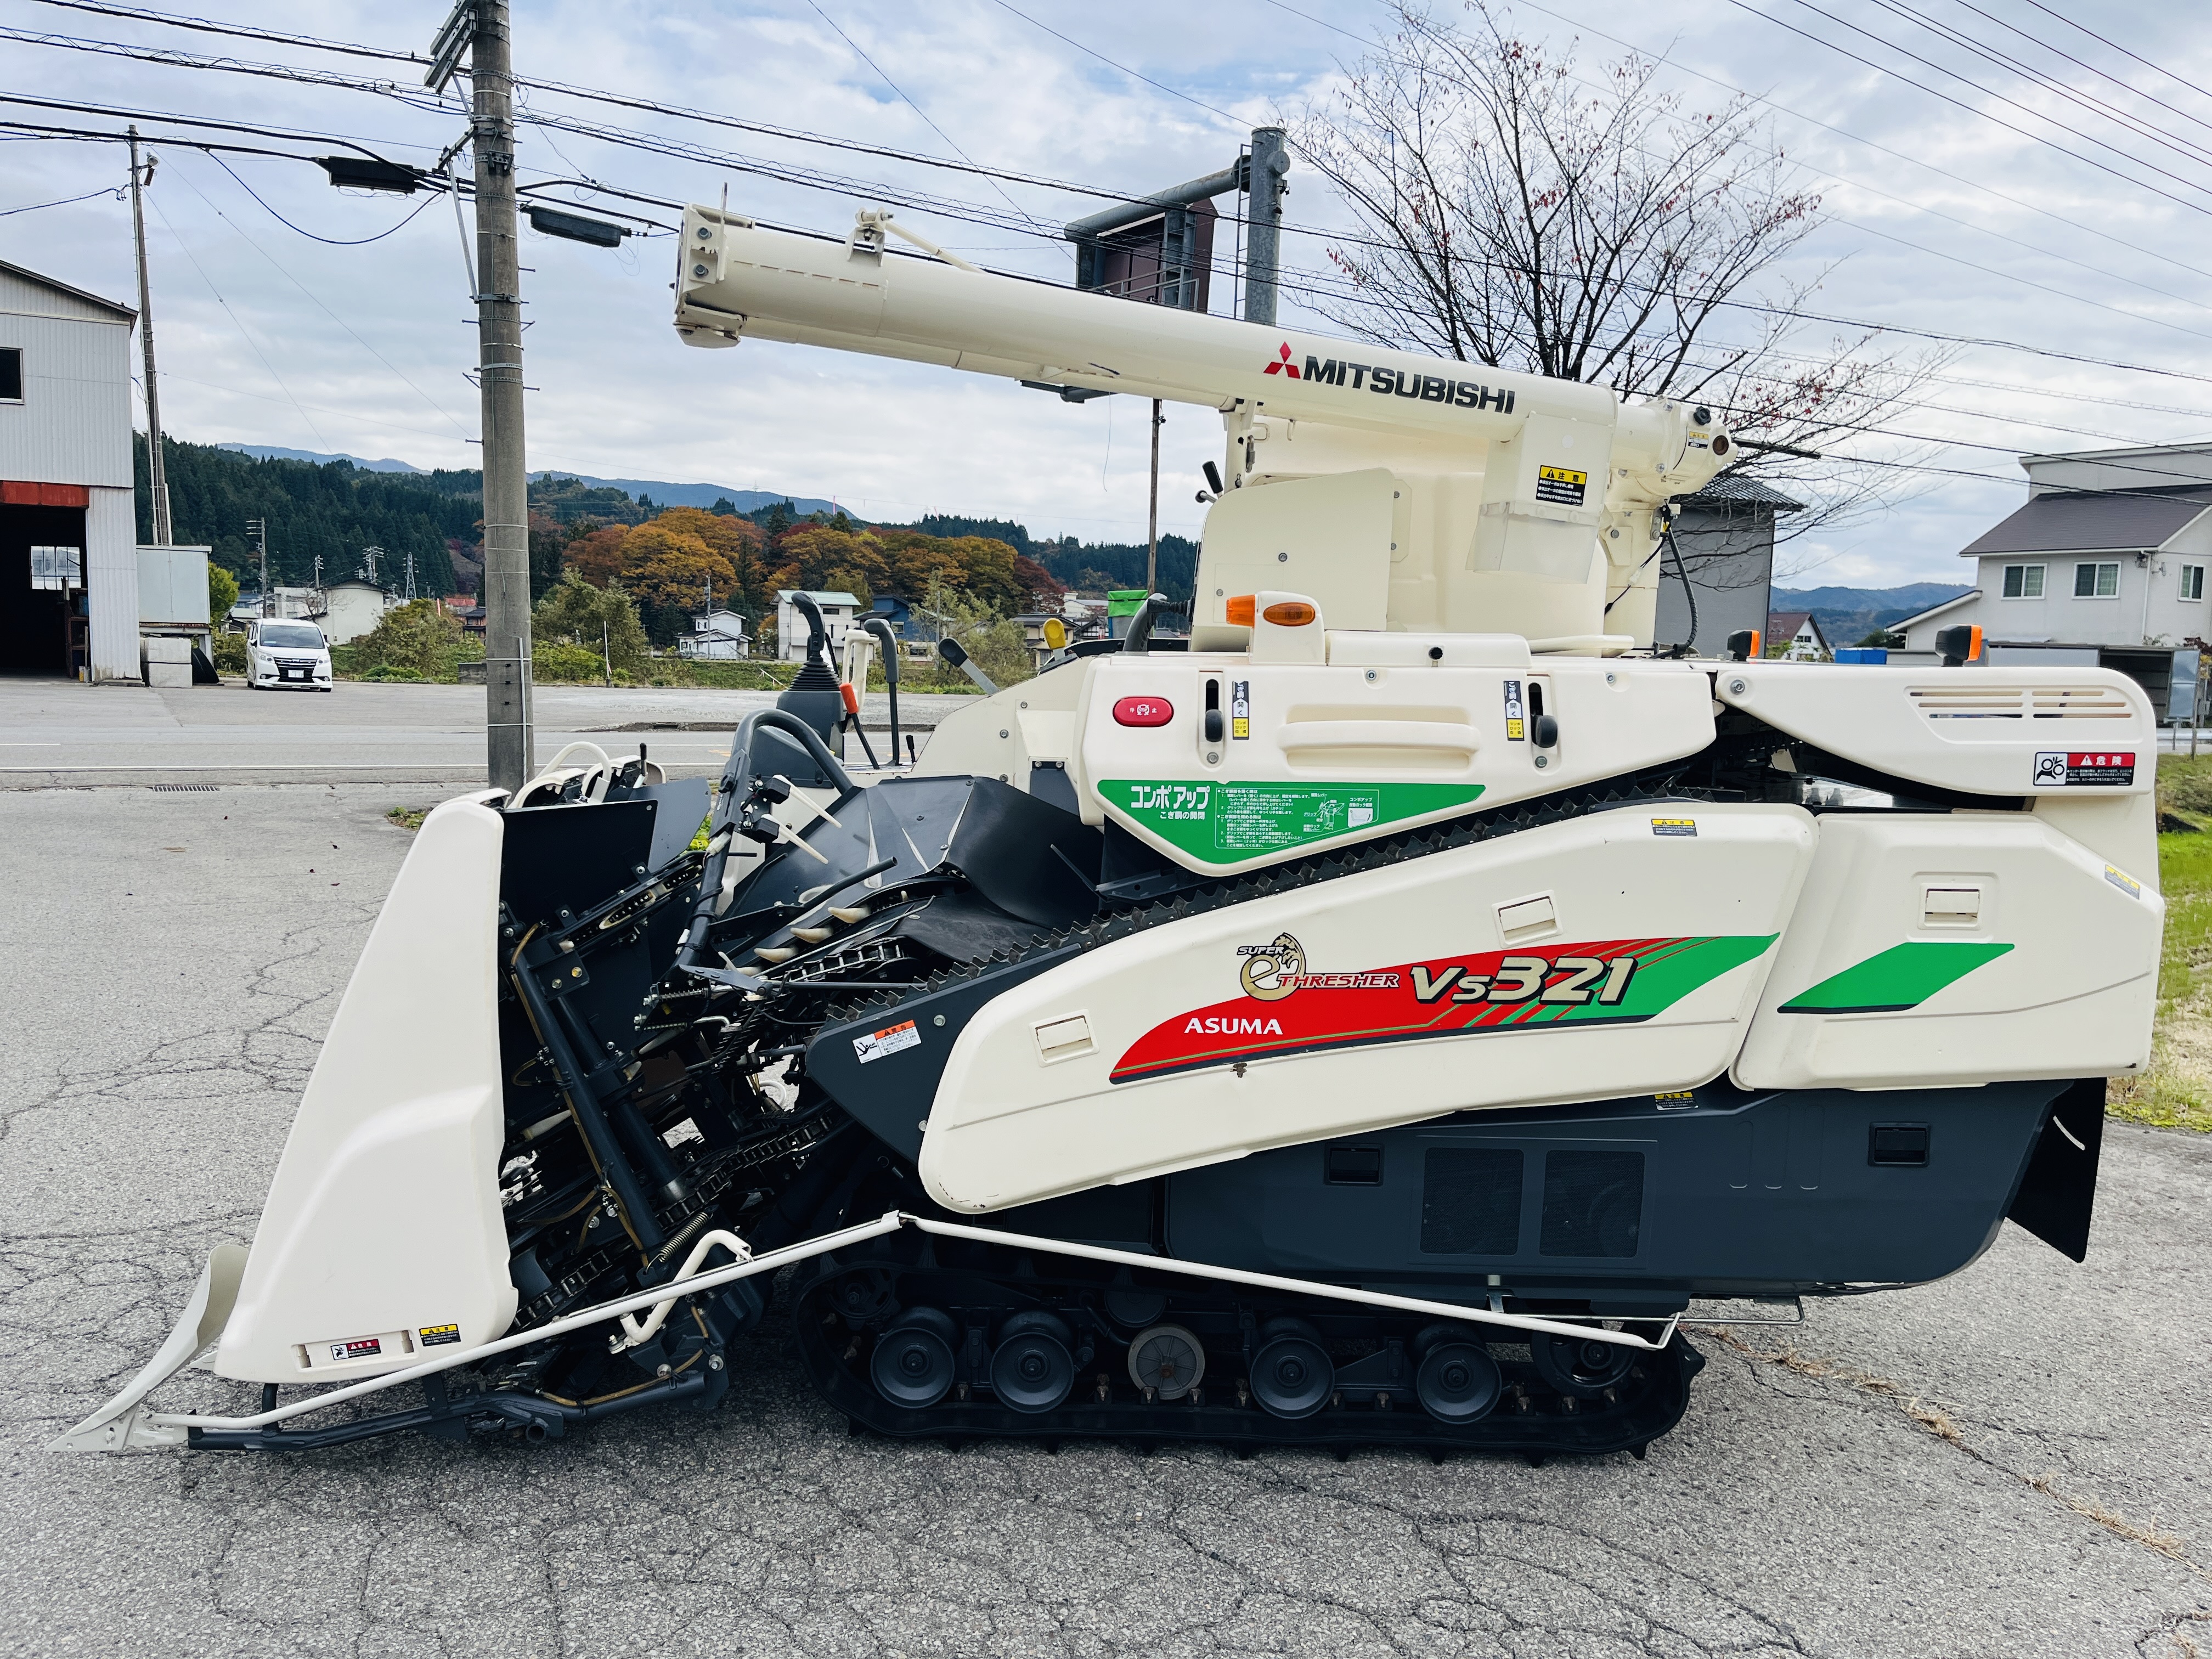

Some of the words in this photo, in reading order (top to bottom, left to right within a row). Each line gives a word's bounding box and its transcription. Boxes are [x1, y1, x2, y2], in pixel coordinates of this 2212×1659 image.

[1304, 355, 1515, 415] MITSUBISHI
[1237, 946, 1285, 955] SUPER
[1277, 973, 1400, 989] THRESHER
[1184, 1017, 1283, 1035] ASUMA
